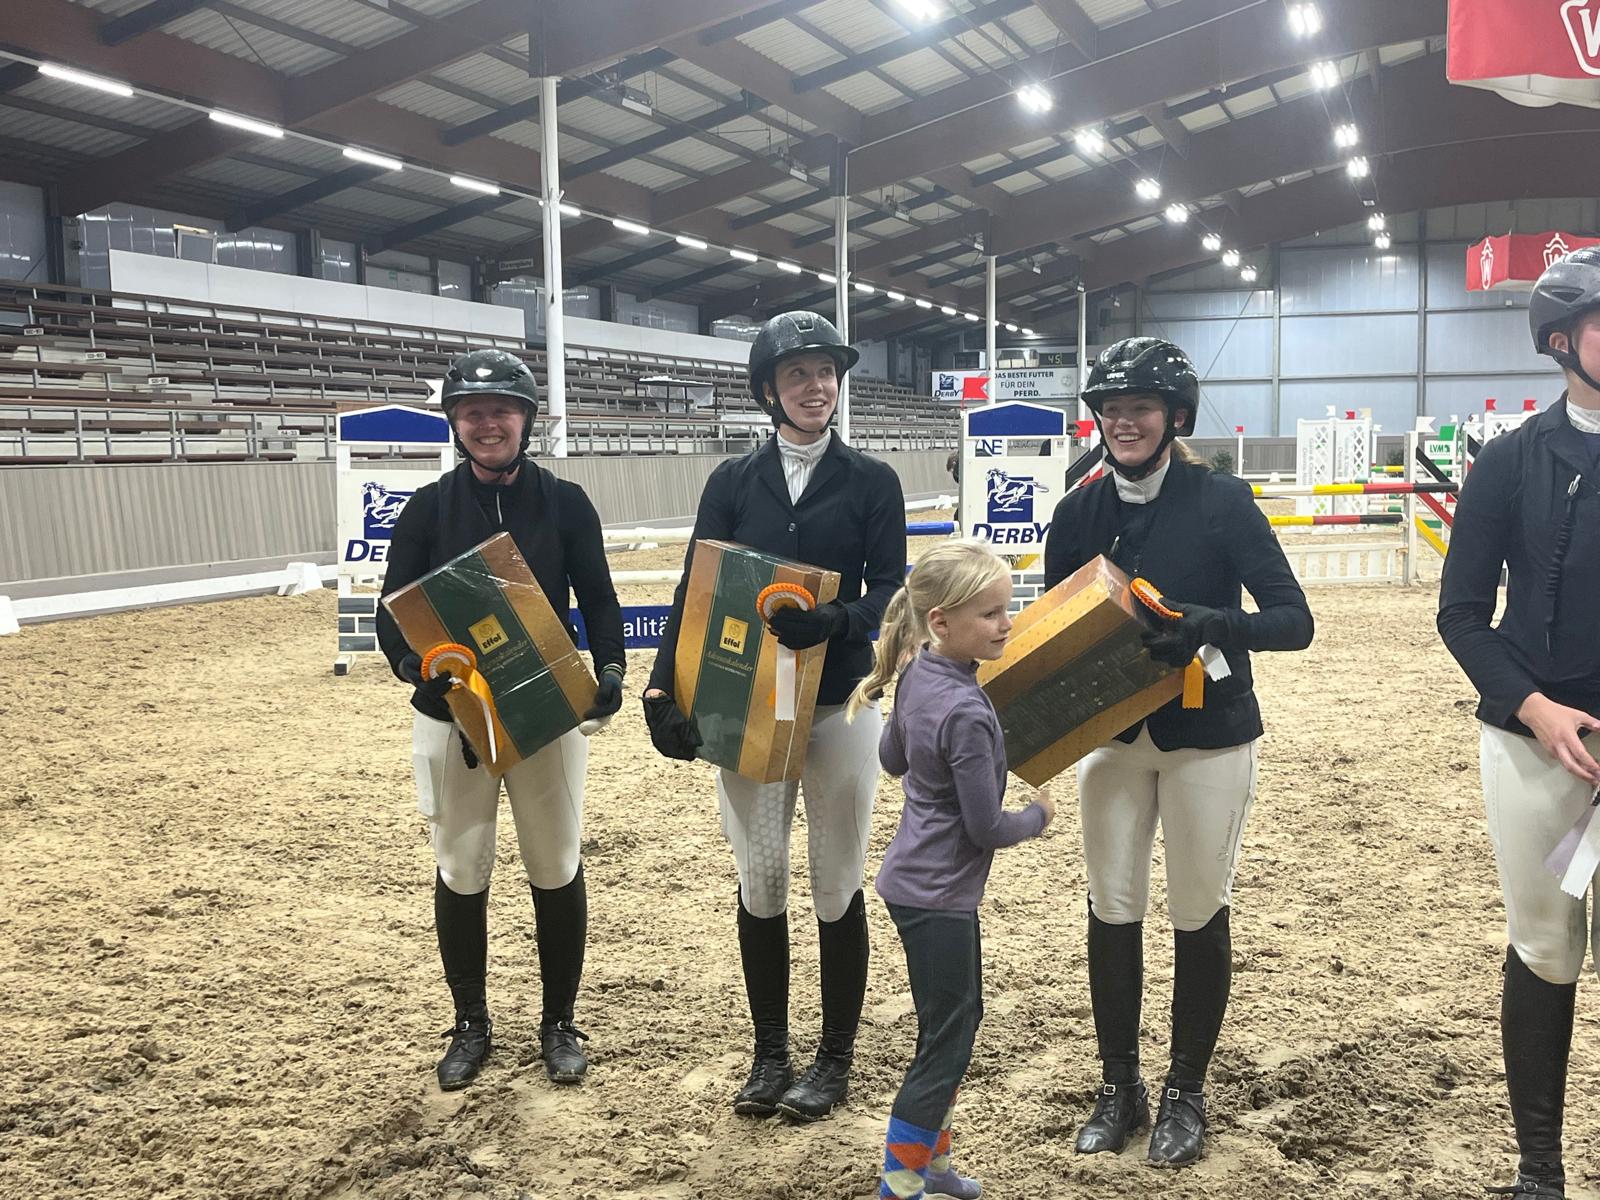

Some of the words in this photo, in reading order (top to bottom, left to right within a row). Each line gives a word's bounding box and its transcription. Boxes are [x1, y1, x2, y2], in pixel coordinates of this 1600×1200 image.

[1001, 380, 1015, 388] FÜR
[1017, 380, 1035, 388] DEIN
[934, 389, 960, 398] DERBY
[1014, 389, 1041, 397] PFERD.
[972, 522, 1052, 544] DERBY
[481, 633, 502, 649] Effol
[723, 637, 741, 649] Effol
